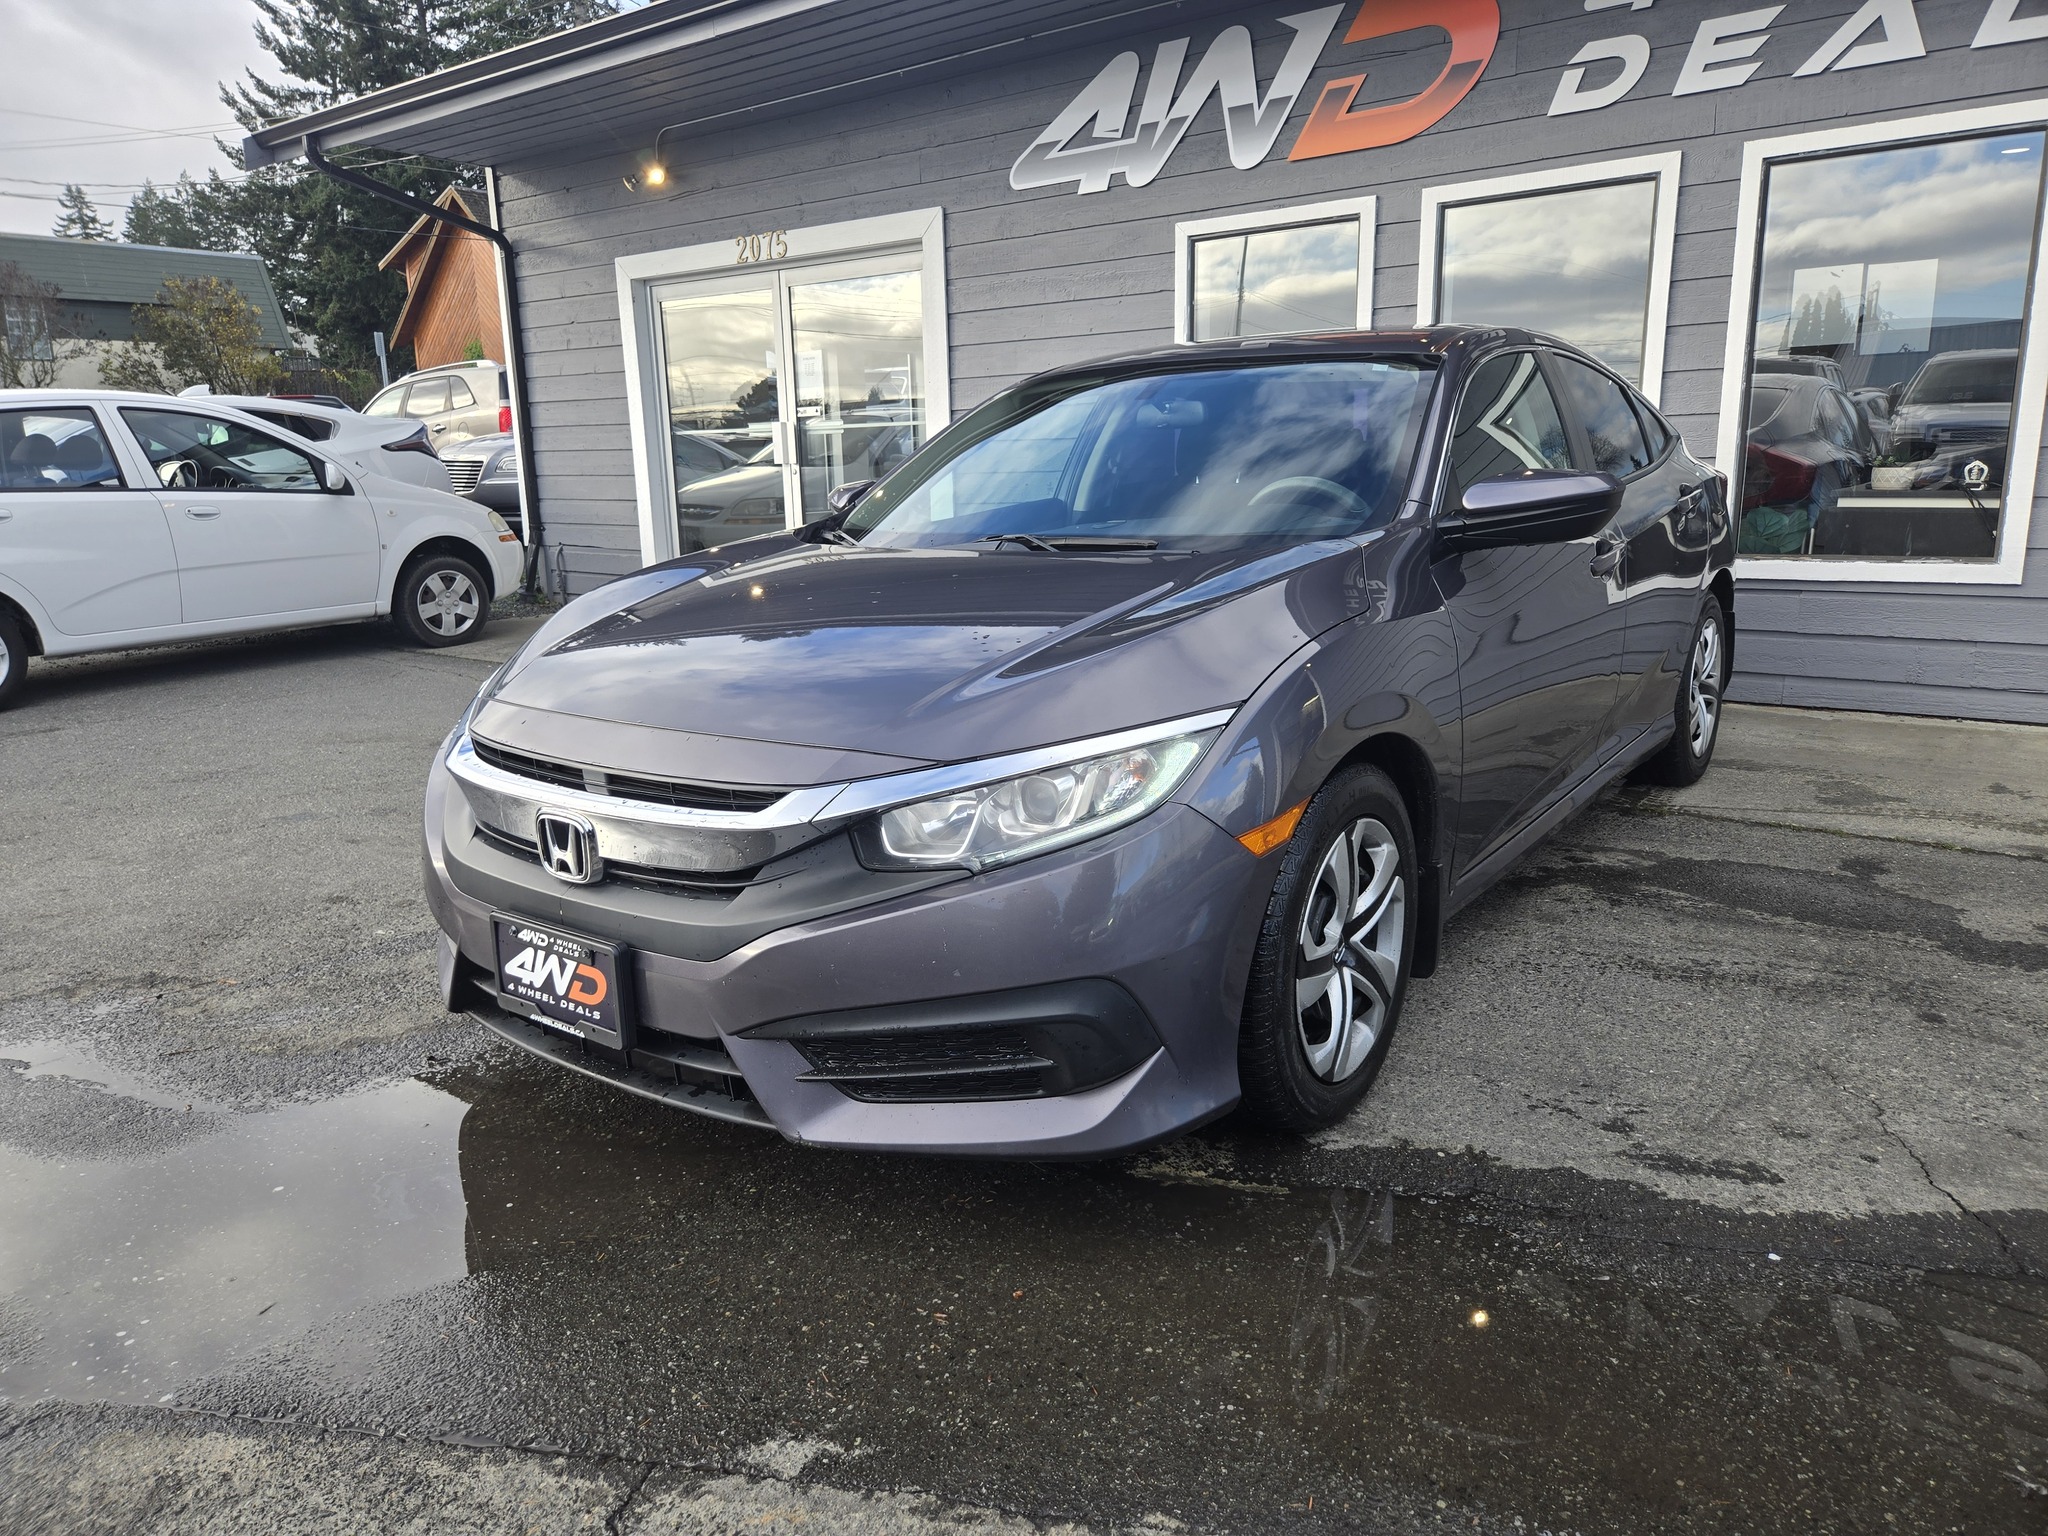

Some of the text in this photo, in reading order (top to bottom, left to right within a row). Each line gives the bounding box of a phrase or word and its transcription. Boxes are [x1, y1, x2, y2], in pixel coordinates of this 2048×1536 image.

[1009, 0, 1502, 195] 4WD
[735, 229, 788, 265] 2075
[517, 929, 549, 946] 4WD
[553, 945, 580, 957] DEALS
[556, 938, 582, 951] WHEEL
[504, 947, 608, 1006] 4WD
[507, 982, 602, 1020] 4 WHEEL DEALS
